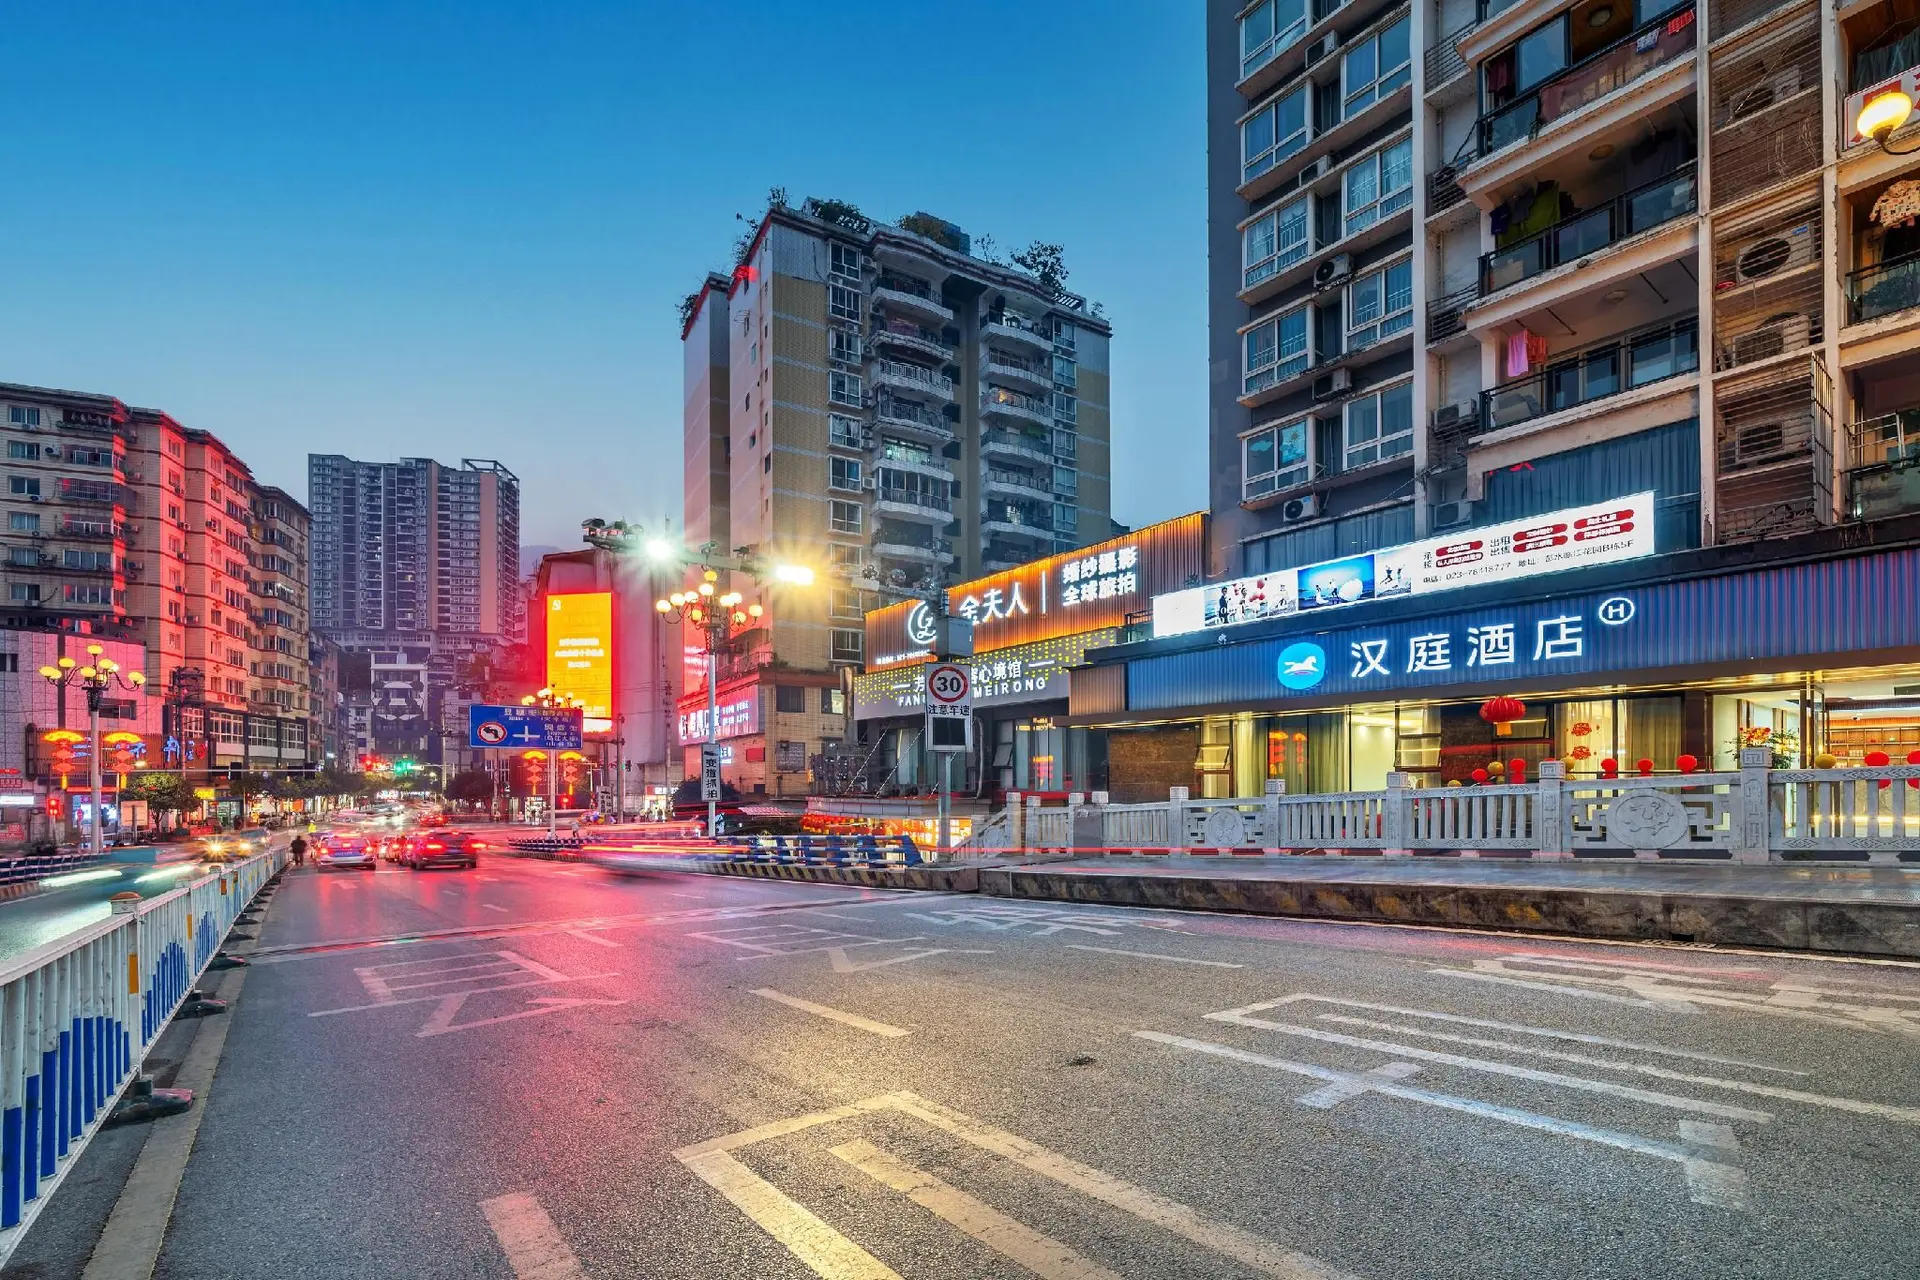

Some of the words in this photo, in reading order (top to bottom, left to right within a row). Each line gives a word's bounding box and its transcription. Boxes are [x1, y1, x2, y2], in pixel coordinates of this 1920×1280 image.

[1490, 536, 1511, 548] 出租
[1490, 545, 1511, 557] 出售
[1062, 545, 1138, 584] 婚纱摄影
[958, 581, 1029, 626] 金夫人
[1062, 572, 1137, 607] 全球旅拍
[1350, 614, 1585, 679] 汉庭酒店
[936, 676, 962, 693] 30
[973, 677, 1046, 699] MEIRONG
[928, 704, 971, 717] 注意车速
[705, 758, 718, 799] 变道抓拍
